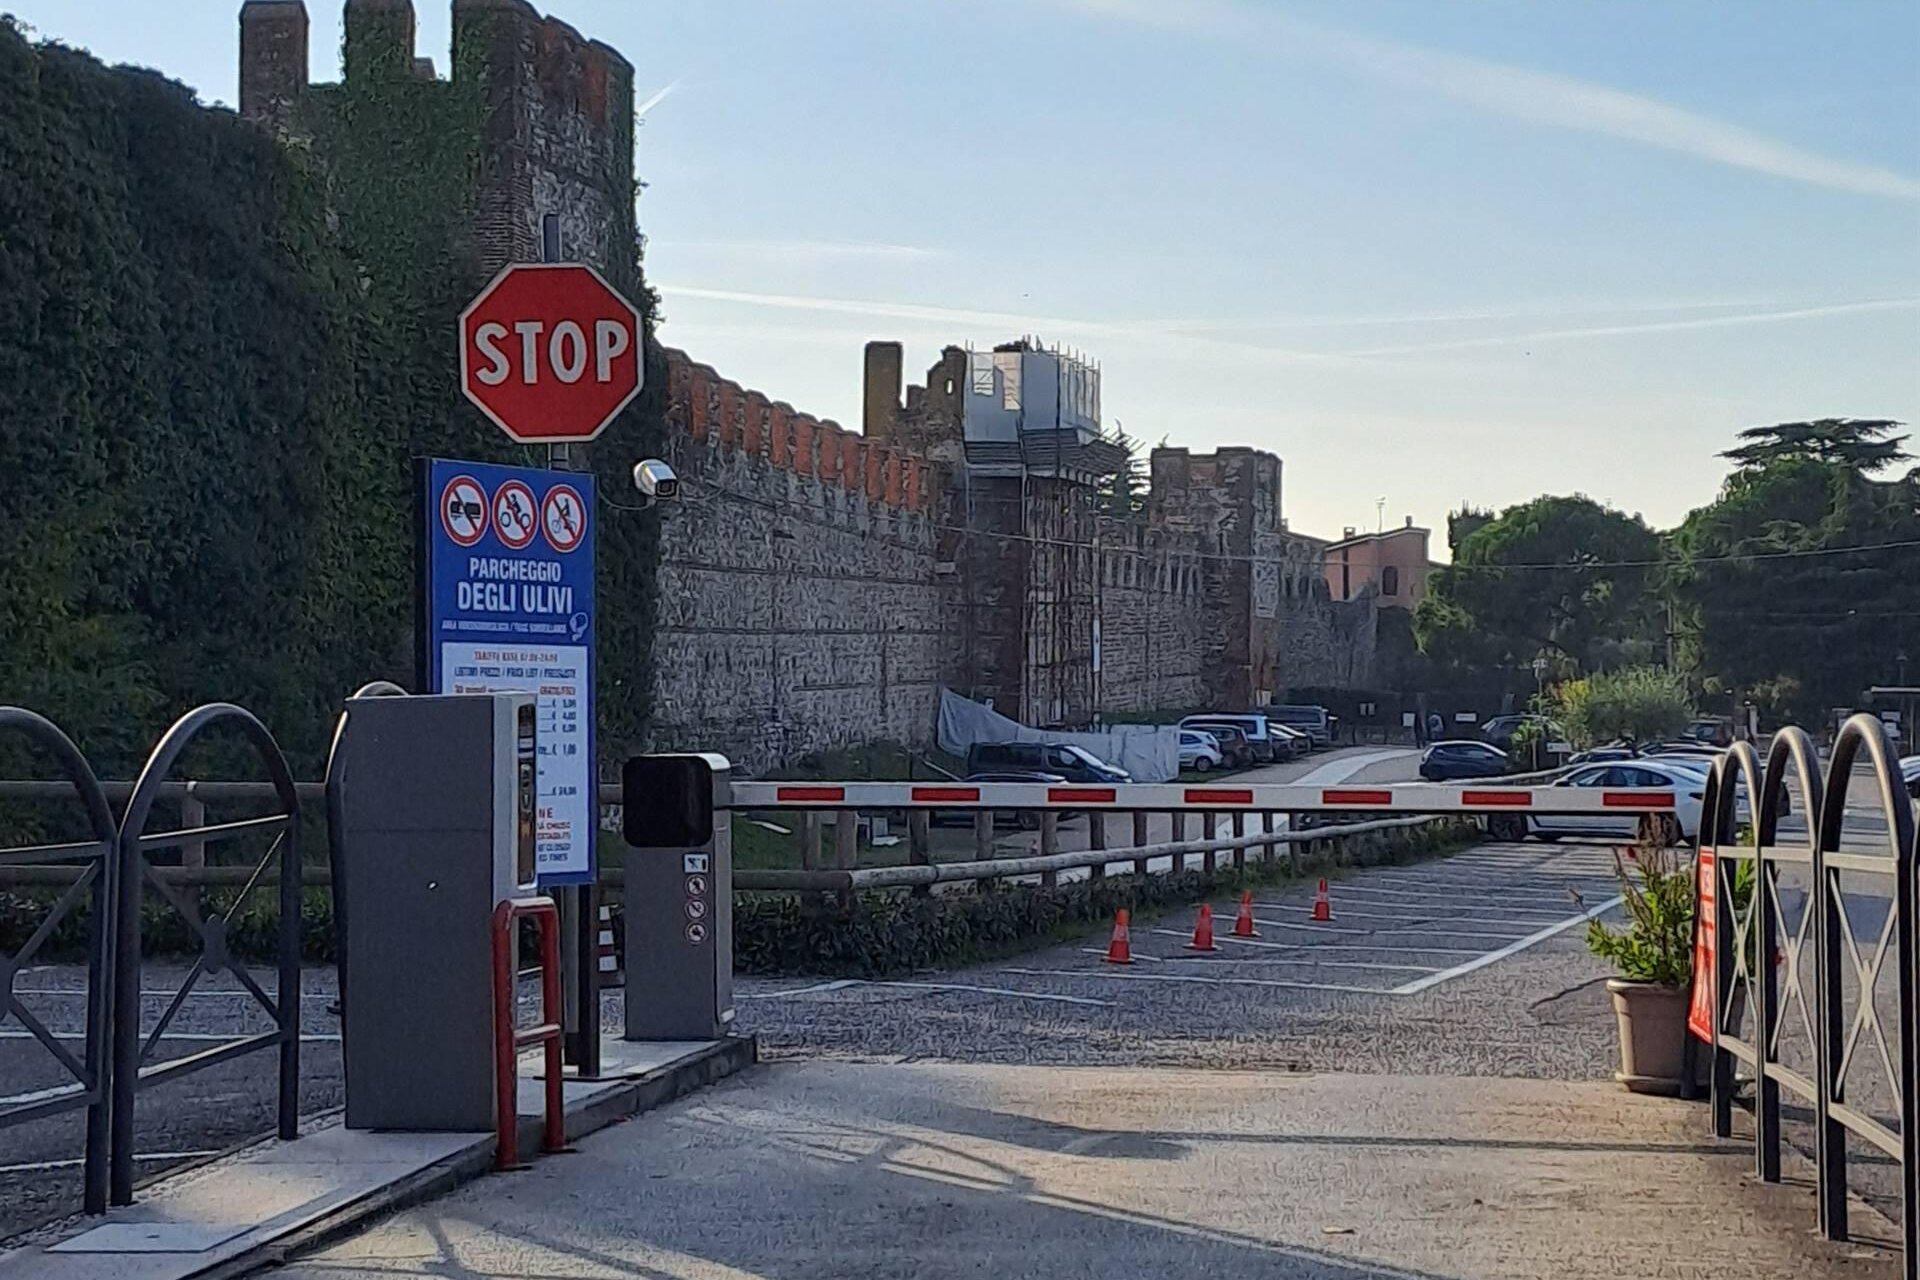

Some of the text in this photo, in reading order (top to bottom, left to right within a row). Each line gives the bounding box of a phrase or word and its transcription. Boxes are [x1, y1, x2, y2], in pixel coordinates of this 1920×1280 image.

[475, 320, 629, 385] STOP
[469, 557, 562, 582] PARCHEGGIO
[457, 581, 573, 614] DEGLI ULIVI
